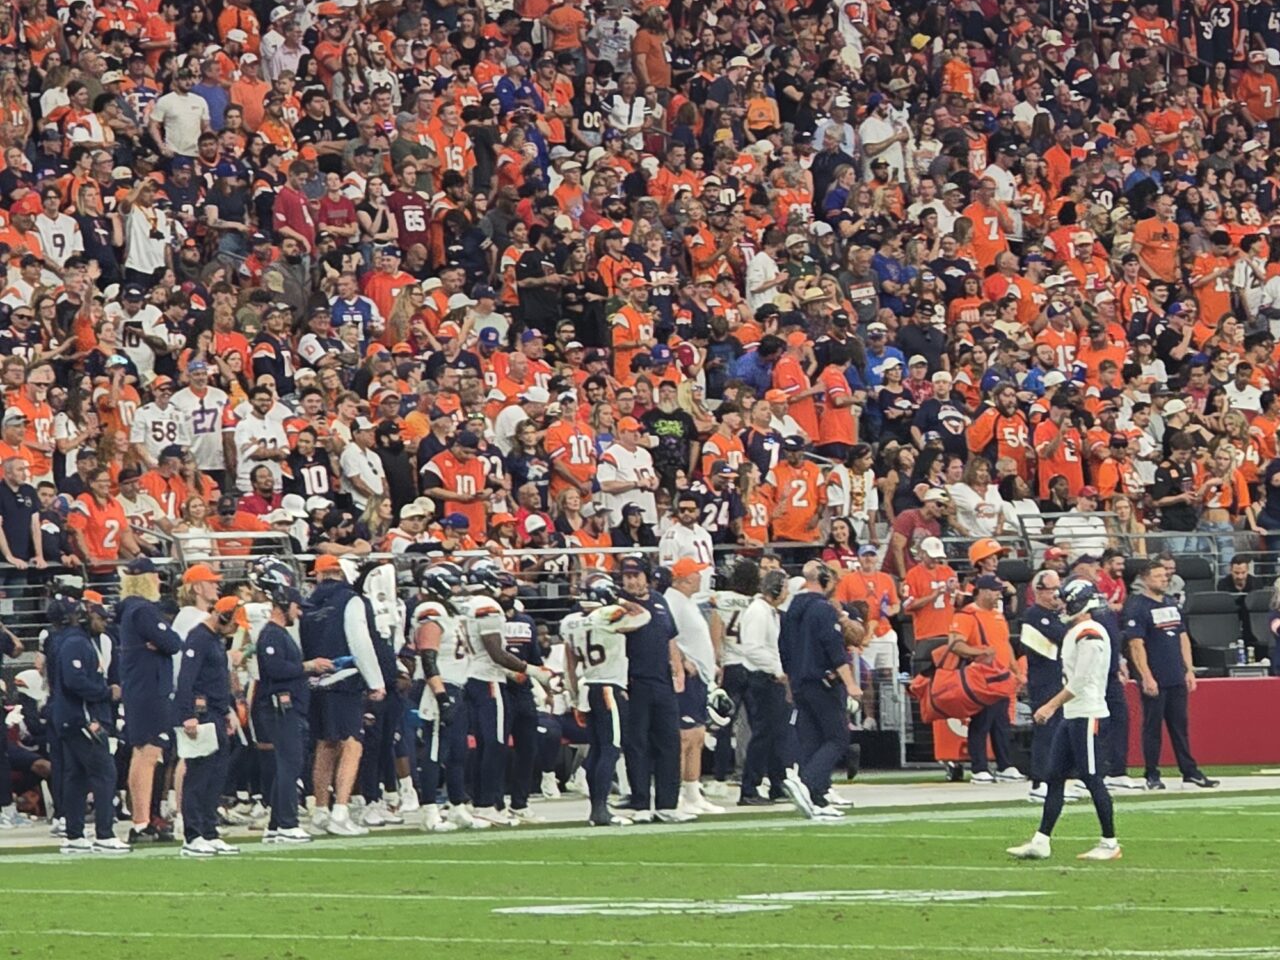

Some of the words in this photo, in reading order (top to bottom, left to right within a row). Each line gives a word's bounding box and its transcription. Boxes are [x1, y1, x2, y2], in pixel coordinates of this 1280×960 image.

[1260, 86, 1271, 107] 7
[584, 111, 600, 128] 00
[446, 146, 464, 170] 15
[984, 217, 998, 239] 7
[54, 234, 66, 256] 9
[1131, 298, 1147, 313] 12
[153, 422, 176, 441] 58
[194, 408, 217, 433] 27
[569, 435, 591, 463] 10
[301, 468, 328, 494] 10
[455, 476, 475, 494] 10
[792, 480, 809, 506] 2
[704, 504, 728, 531] 24
[749, 504, 766, 525] 18
[104, 523, 118, 547] 2
[694, 541, 711, 564] 11
[725, 598, 750, 609] SINGL
